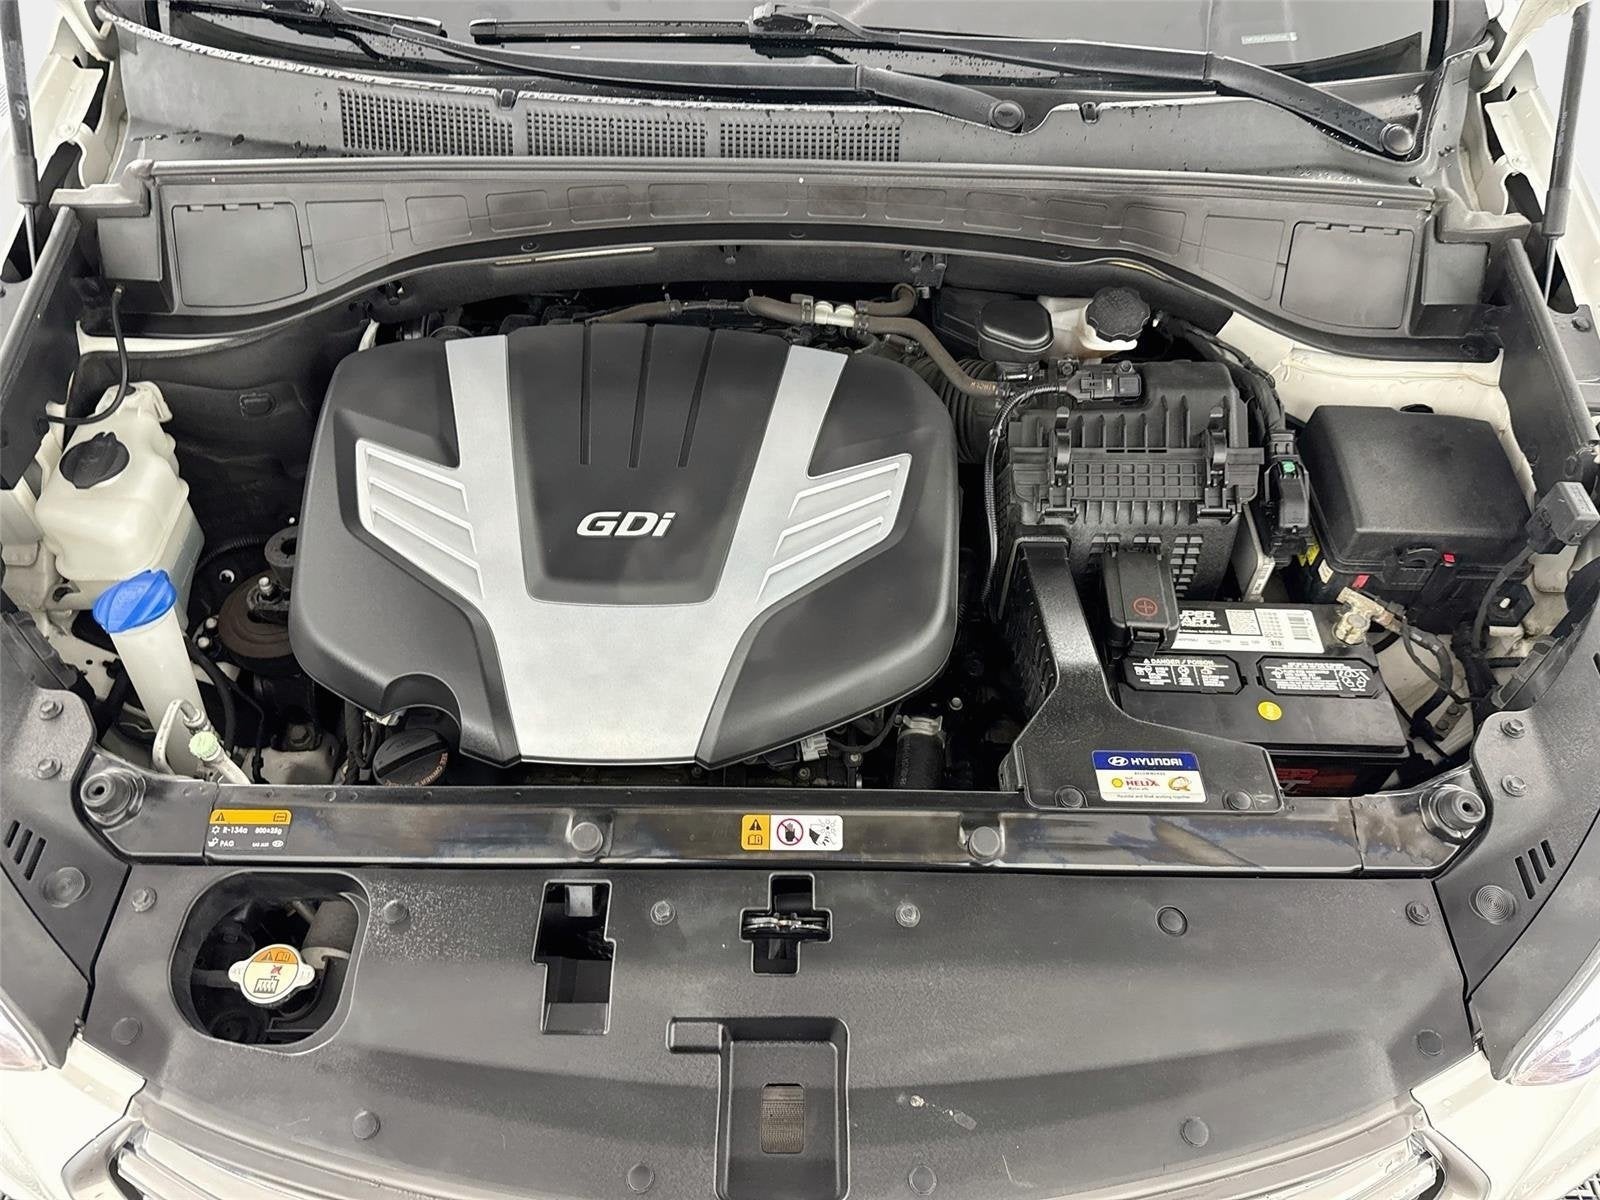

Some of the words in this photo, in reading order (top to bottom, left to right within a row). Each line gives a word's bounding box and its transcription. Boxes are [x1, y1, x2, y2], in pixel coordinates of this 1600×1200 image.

[576, 511, 676, 537] GDi
[1150, 658, 1180, 667] DANGER
[1131, 757, 1183, 766] HYUNDAI
